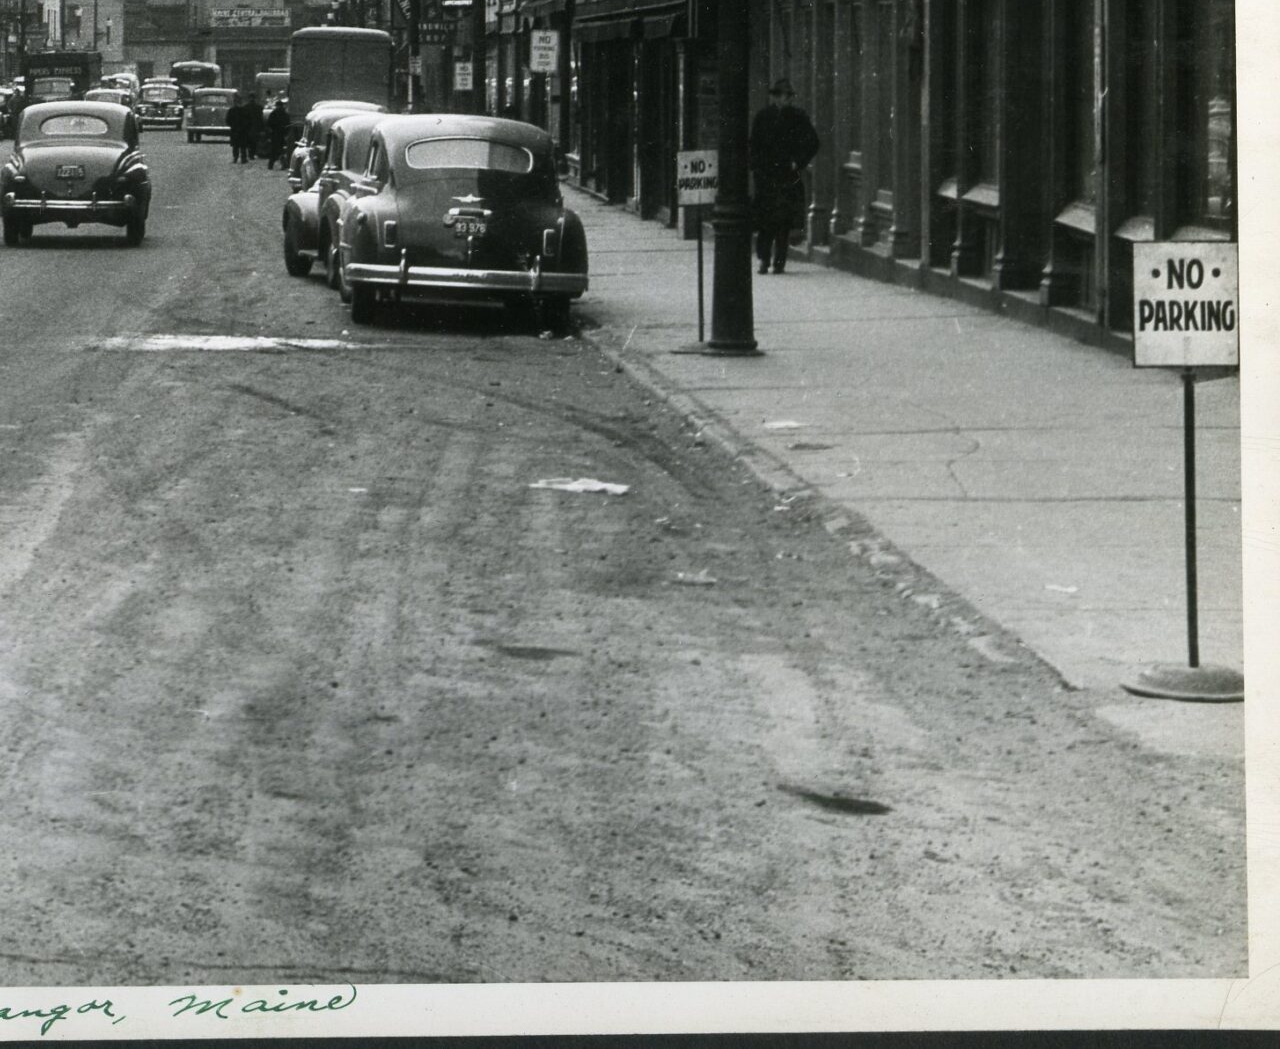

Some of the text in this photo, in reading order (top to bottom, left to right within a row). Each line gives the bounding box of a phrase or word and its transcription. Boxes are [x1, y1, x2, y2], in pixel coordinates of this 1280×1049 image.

[690, 159, 706, 174] NO
[678, 176, 719, 191] PARKING
[1166, 258, 1205, 290] NO
[1138, 299, 1236, 332] PARKING
